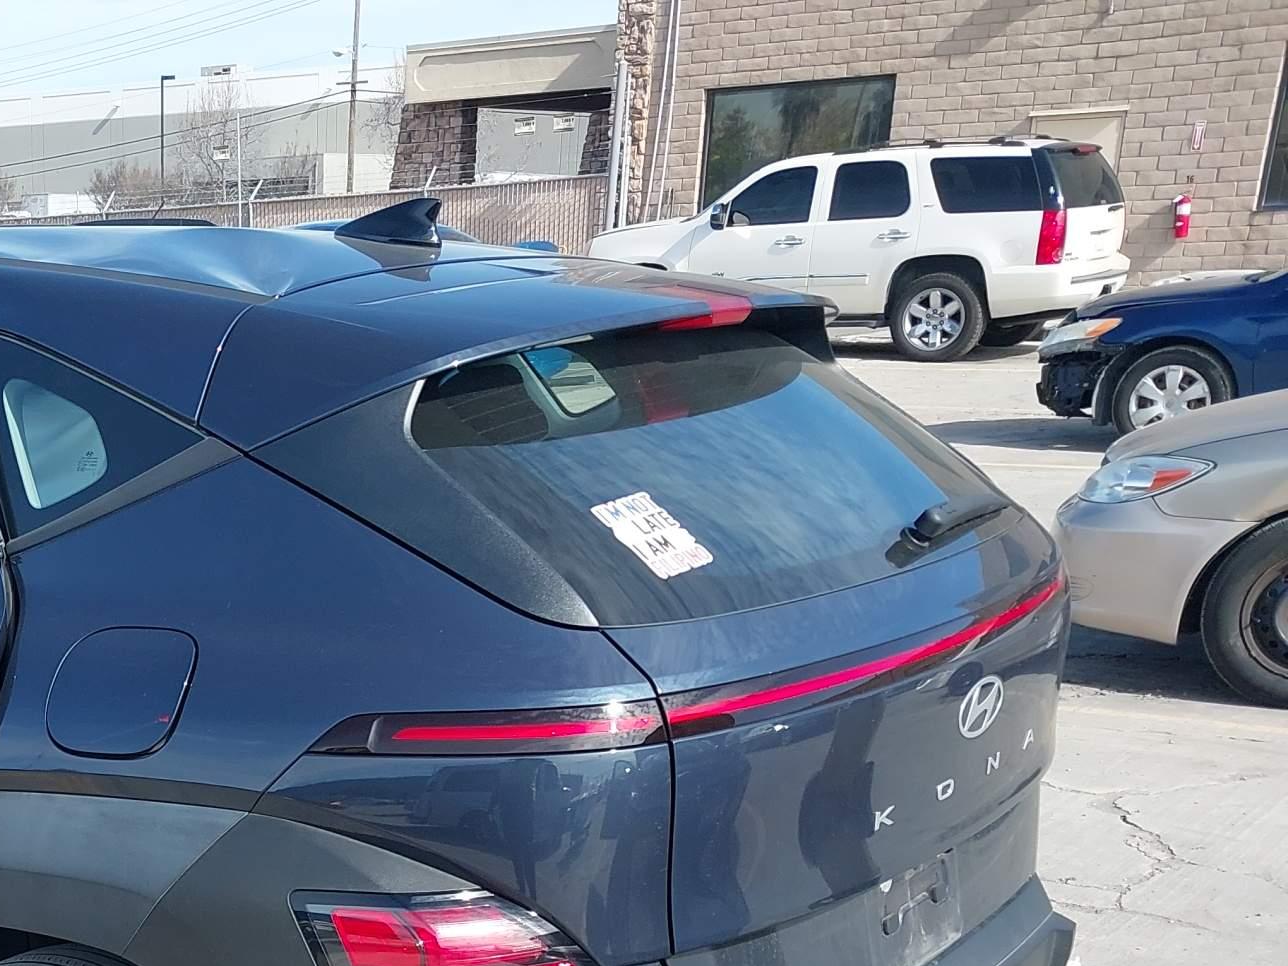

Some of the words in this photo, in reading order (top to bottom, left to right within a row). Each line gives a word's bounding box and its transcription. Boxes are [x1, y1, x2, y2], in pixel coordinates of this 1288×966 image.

[621, 495, 658, 516] NOT
[632, 510, 677, 535] LATE
[632, 544, 649, 561] I
[645, 534, 677, 557] AM
[650, 546, 711, 576] FILIPINO
[873, 728, 1035, 833] KONA
